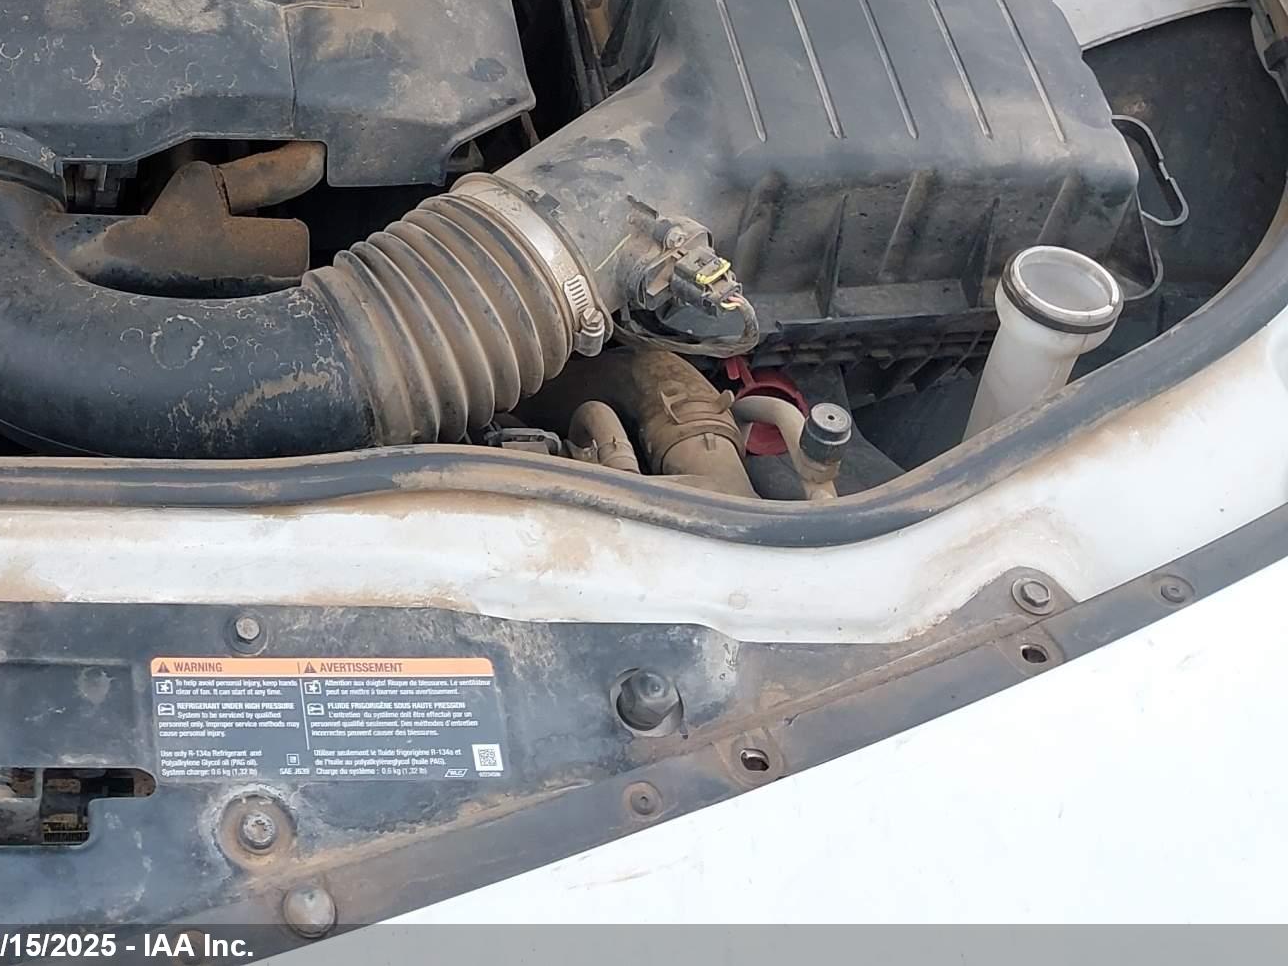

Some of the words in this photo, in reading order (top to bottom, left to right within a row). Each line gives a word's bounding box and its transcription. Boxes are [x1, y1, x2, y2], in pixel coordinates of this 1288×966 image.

[174, 662, 223, 673] WARNING
[320, 662, 403, 673] AVERTISSEMENT
[178, 712, 200, 720] System
[255, 712, 281, 720] qualified
[159, 721, 189, 729] personnel
[179, 730, 205, 738] personal
[174, 750, 187, 758] only
[212, 750, 247, 758] Refrigerant
[316, 768, 338, 776] Charge
